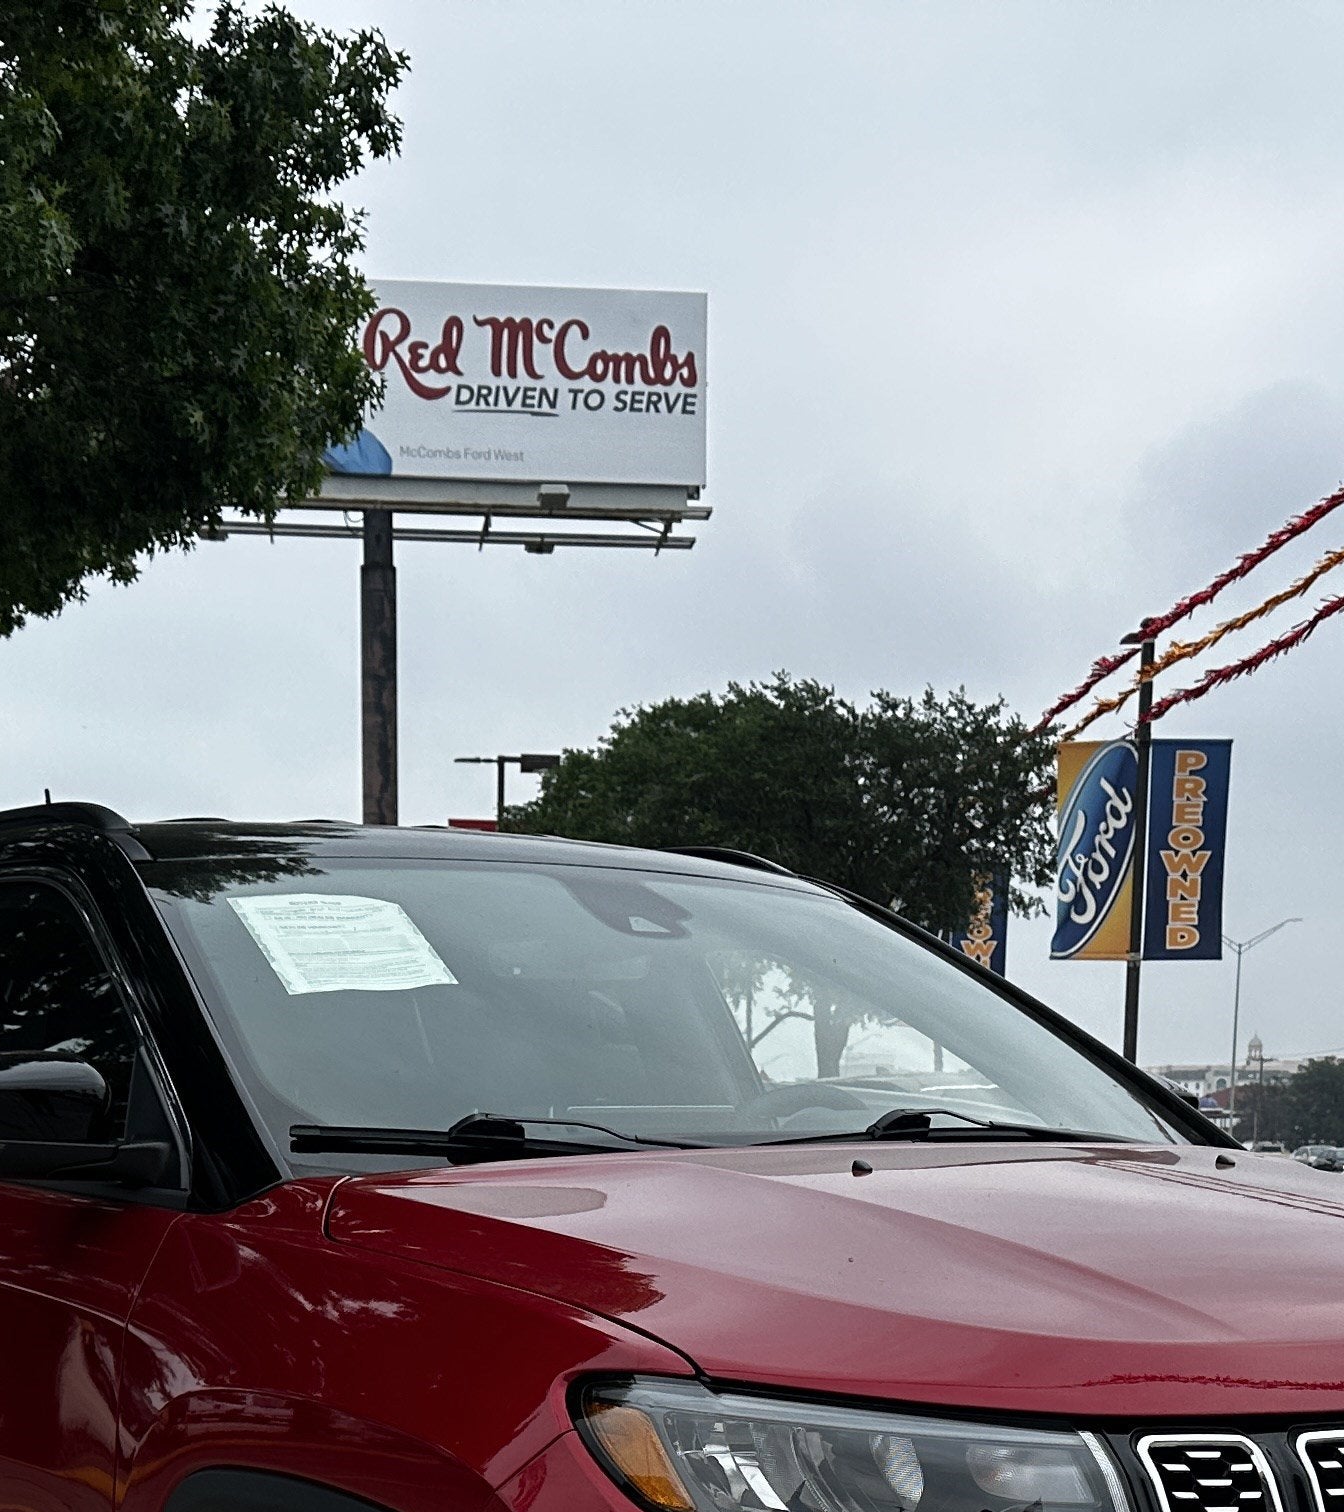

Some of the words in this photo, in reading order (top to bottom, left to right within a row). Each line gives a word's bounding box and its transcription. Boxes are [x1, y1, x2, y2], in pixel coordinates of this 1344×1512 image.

[363, 308, 464, 400] Red
[473, 315, 698, 388] McCombs
[455, 384, 558, 410] DRIVEN
[569, 387, 606, 411] TO
[613, 390, 698, 415] SERVE
[399, 445, 461, 459] McCombs
[463, 447, 491, 461] Ford
[494, 449, 525, 462] West
[1057, 777, 1133, 925] Ford
[1159, 749, 1212, 950] PREOWNED
